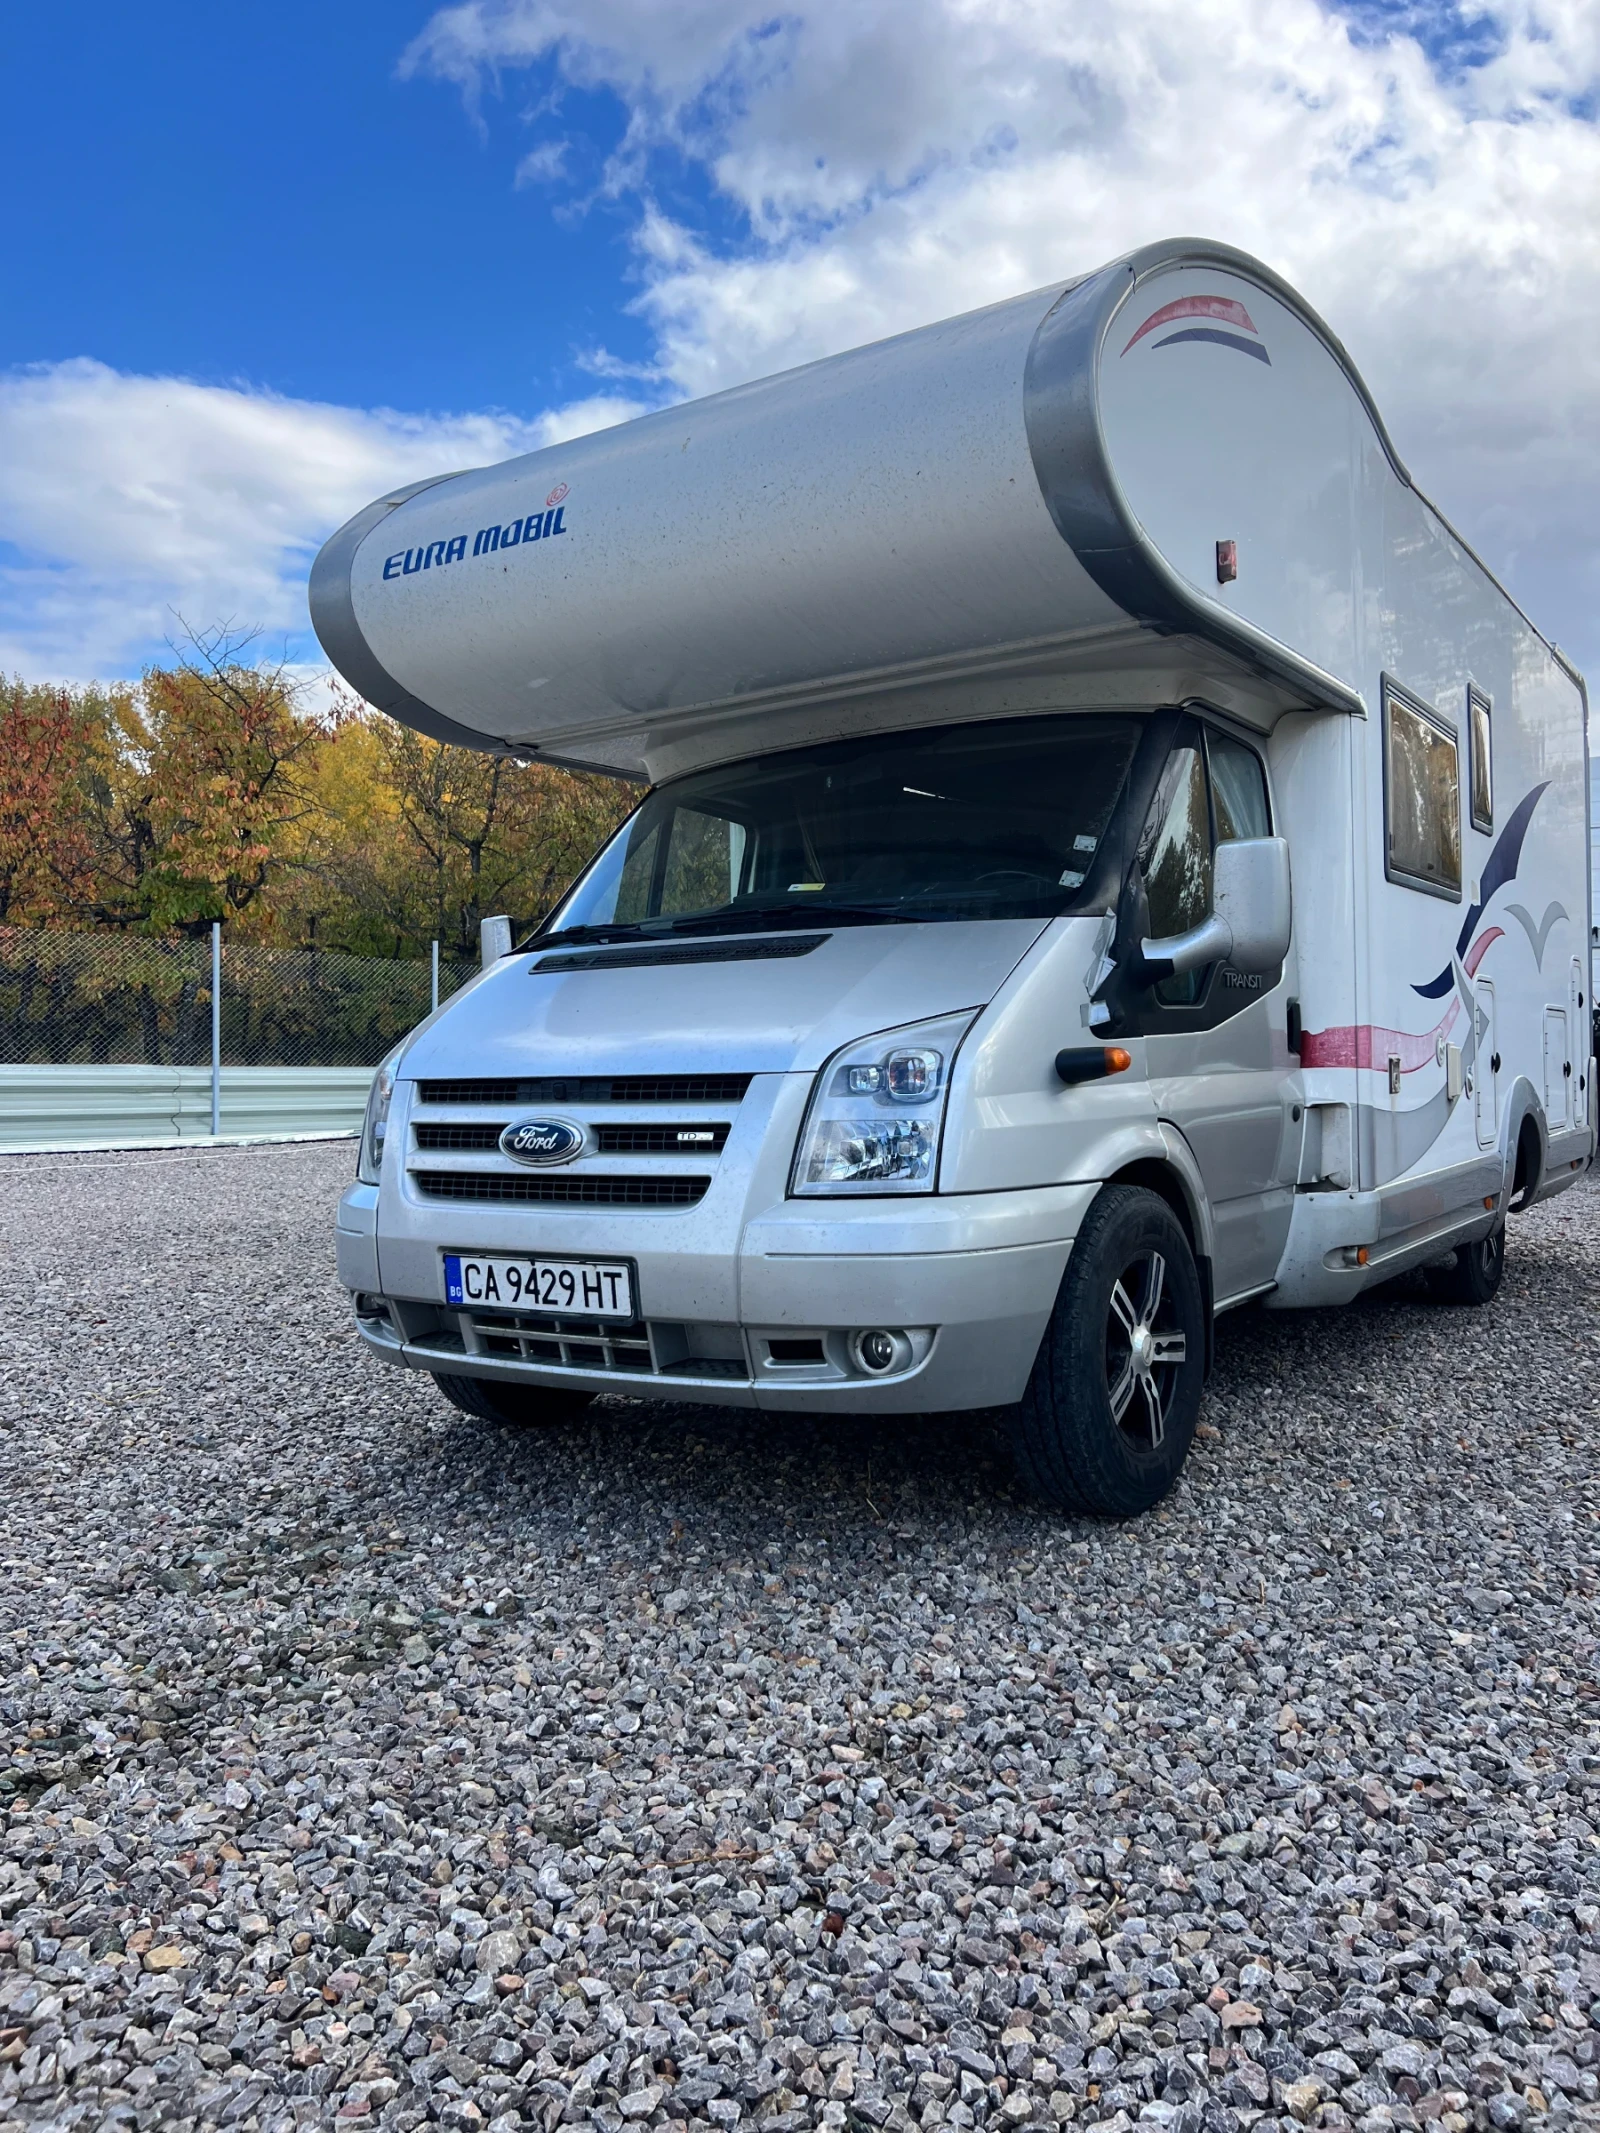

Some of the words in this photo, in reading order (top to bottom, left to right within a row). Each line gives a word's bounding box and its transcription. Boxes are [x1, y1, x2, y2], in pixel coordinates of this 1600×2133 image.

[382, 535, 468, 580] EURA
[473, 506, 567, 557] MOBIL
[1225, 972, 1262, 989] TRANSIT
[514, 1126, 559, 1149] Ford
[450, 1286, 462, 1297] BG
[465, 1264, 501, 1301] CA
[506, 1266, 575, 1307] 9429
[582, 1270, 622, 1309] HT
